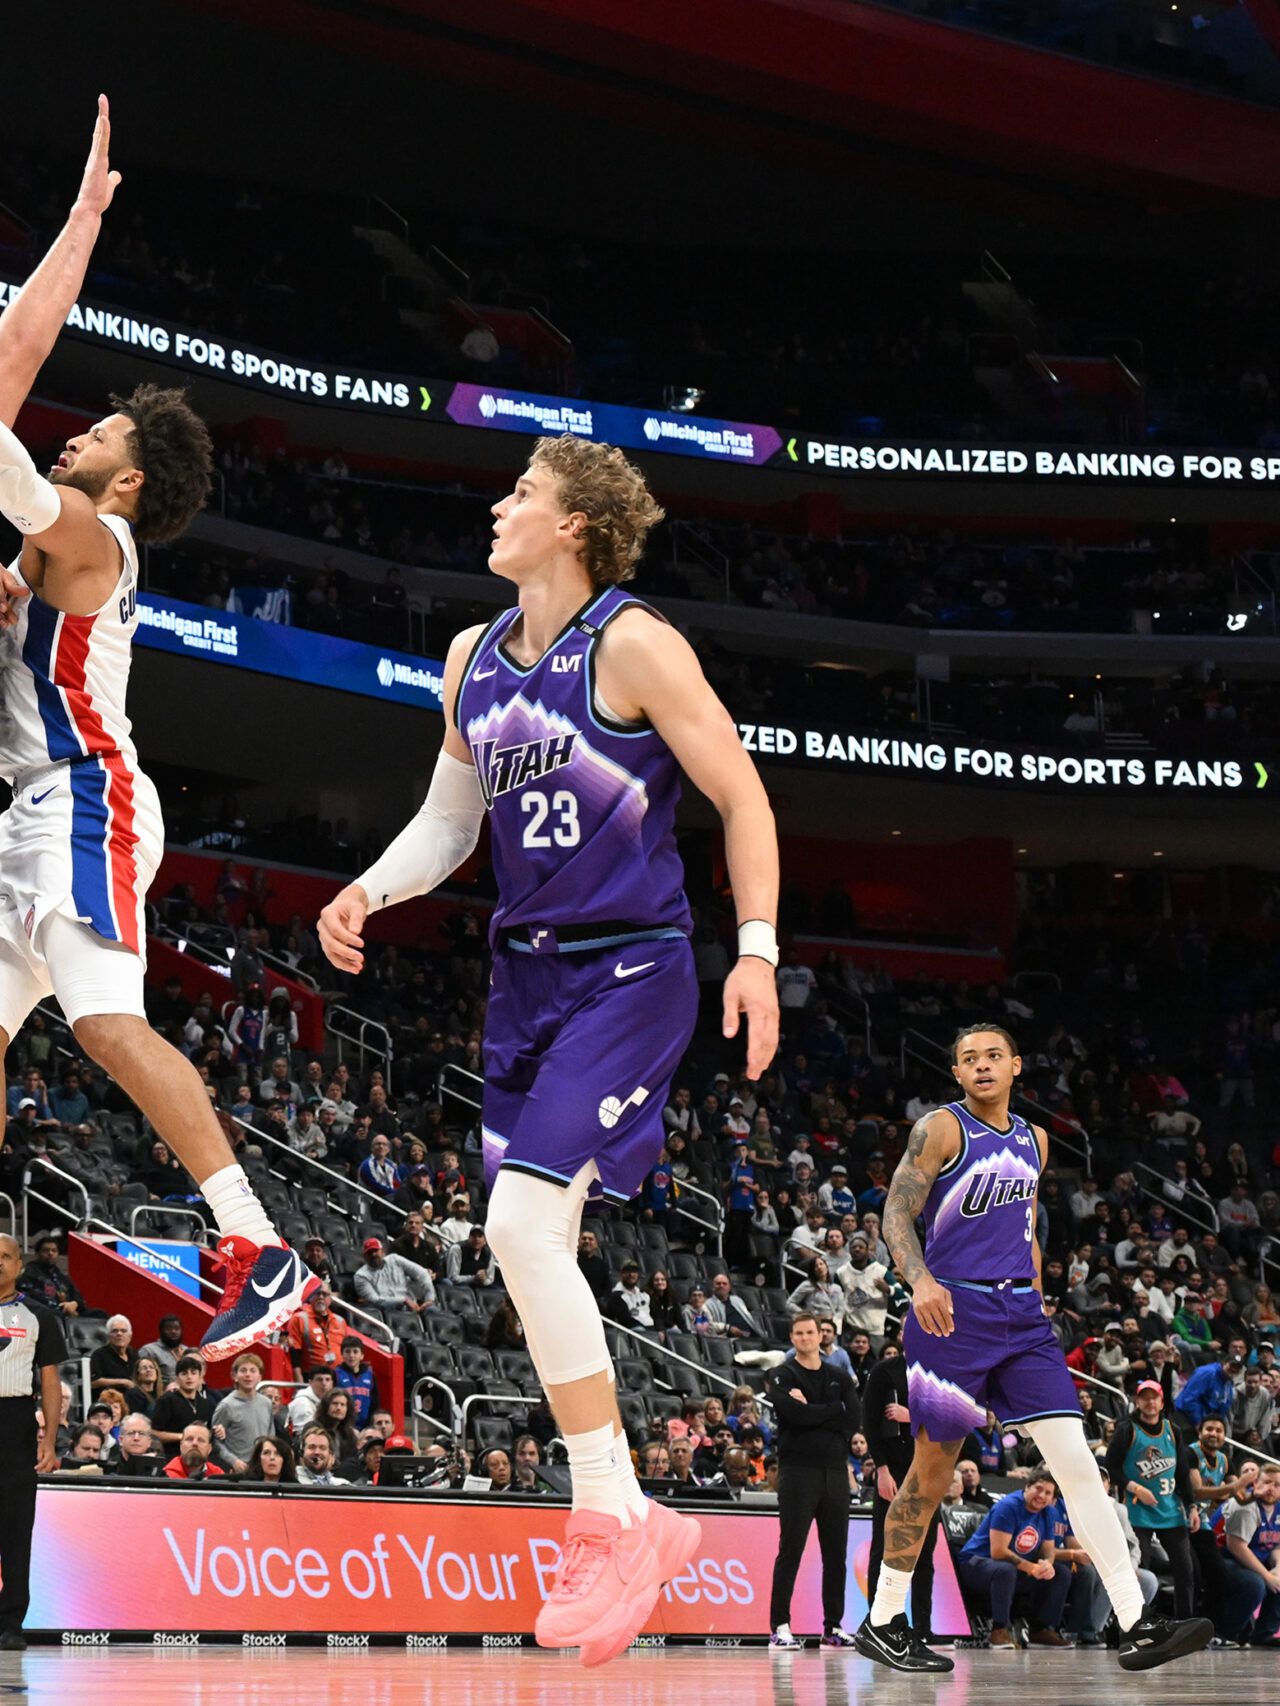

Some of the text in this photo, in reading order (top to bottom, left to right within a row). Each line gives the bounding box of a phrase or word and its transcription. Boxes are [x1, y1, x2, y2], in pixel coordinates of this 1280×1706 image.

[65, 302, 410, 408] ANKING FOR SPORTS FANS
[497, 401, 593, 425] Michigan First
[661, 421, 754, 448] Michigan First
[807, 441, 1028, 474] PERSONALIZED
[1035, 450, 1175, 477] BANKING
[1182, 455, 1243, 480] FOR
[135, 604, 238, 645] Michigan First
[551, 653, 583, 673] LVT
[805, 731, 947, 771] BANKING
[954, 747, 1014, 779] FOR
[1020, 754, 1146, 786] SPORTS
[1154, 759, 1243, 788] FANS
[520, 790, 582, 849] 23
[163, 1527, 330, 1600] Voice
[340, 1533, 392, 1600] of
[396, 1534, 522, 1602] Your
[61, 1631, 110, 1646] StockX
[153, 1632, 200, 1646] StockX
[242, 1633, 287, 1647] StockX
[326, 1633, 370, 1648] StockX
[406, 1634, 448, 1648] StockX
[482, 1635, 522, 1648] StockX
